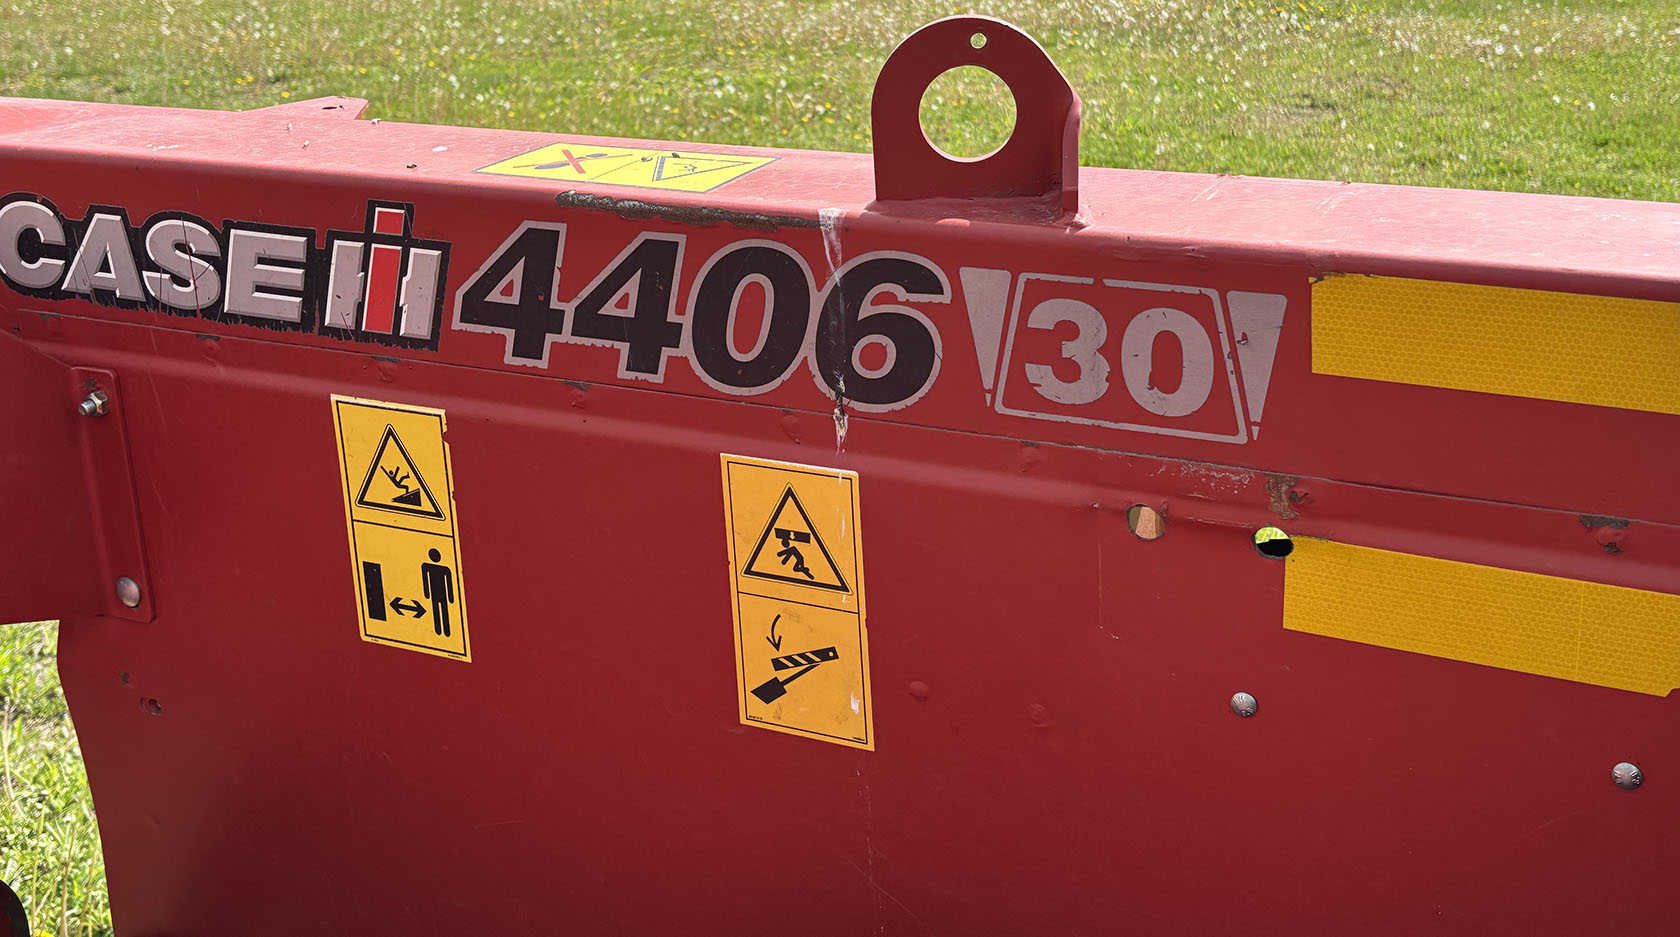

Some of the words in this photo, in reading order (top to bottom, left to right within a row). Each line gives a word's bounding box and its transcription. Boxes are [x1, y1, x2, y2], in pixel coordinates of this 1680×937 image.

[0, 198, 308, 323] CASE
[453, 220, 951, 412] 4406
[1025, 298, 1214, 416] 30
